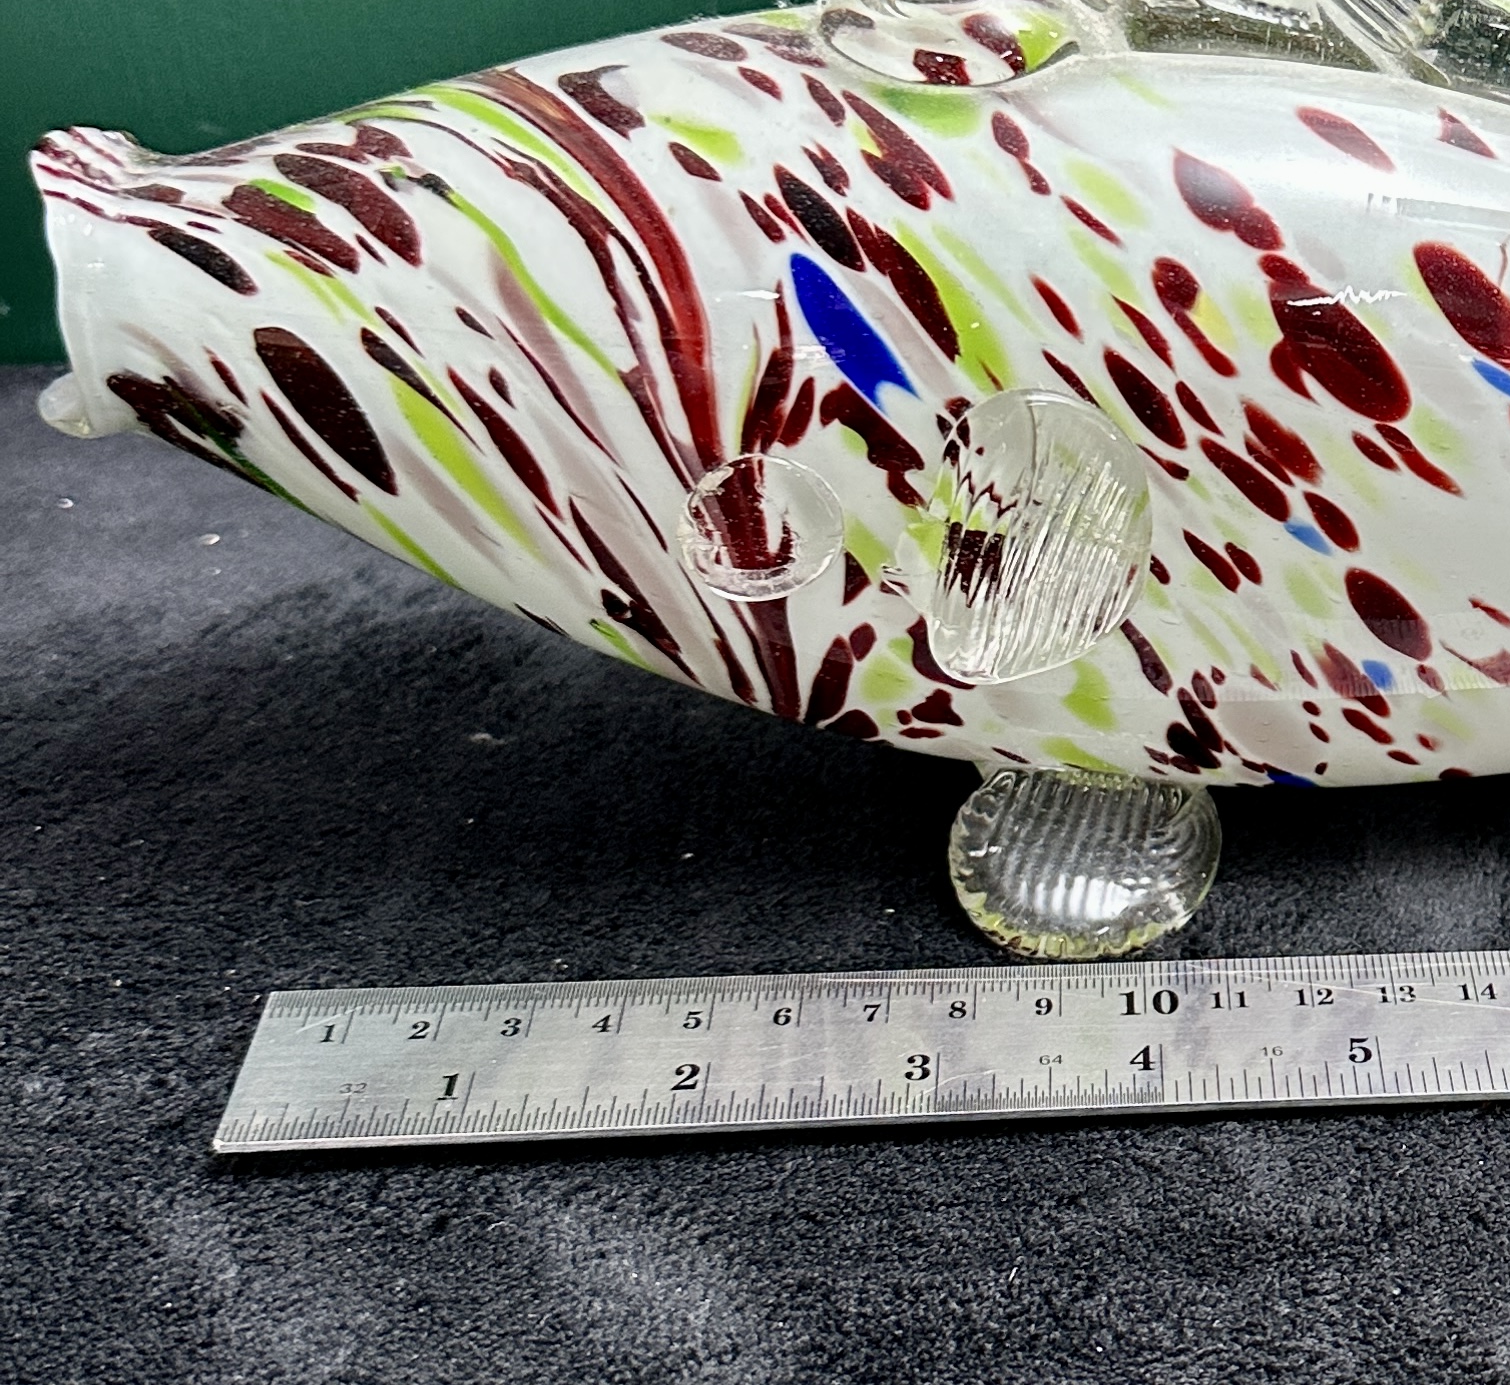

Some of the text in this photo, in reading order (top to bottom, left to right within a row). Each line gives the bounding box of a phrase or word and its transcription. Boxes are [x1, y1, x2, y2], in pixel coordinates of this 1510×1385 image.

[320, 1023, 336, 1043] 1
[409, 1021, 431, 1040] 2
[500, 1017, 523, 1037] 3
[591, 1014, 612, 1034] 4
[682, 1010, 702, 1030] 5
[772, 1007, 792, 1026] 6
[862, 1004, 881, 1022] 7
[948, 1000, 968, 1020] 8
[1034, 997, 1054, 1016] 9
[1119, 988, 1179, 1016] 10
[1210, 988, 1249, 1009] 11
[1296, 988, 1334, 1007] 12
[1378, 985, 1416, 1004] 13
[1458, 983, 1498, 1001] 14
[439, 1074, 460, 1100] 1
[672, 1064, 700, 1090] 2
[904, 1054, 930, 1082] 3
[1129, 1045, 1155, 1072] 4
[1348, 1037, 1372, 1064] 5
[1038, 1054, 1063, 1066] 64
[1260, 1045, 1283, 1057] 16
